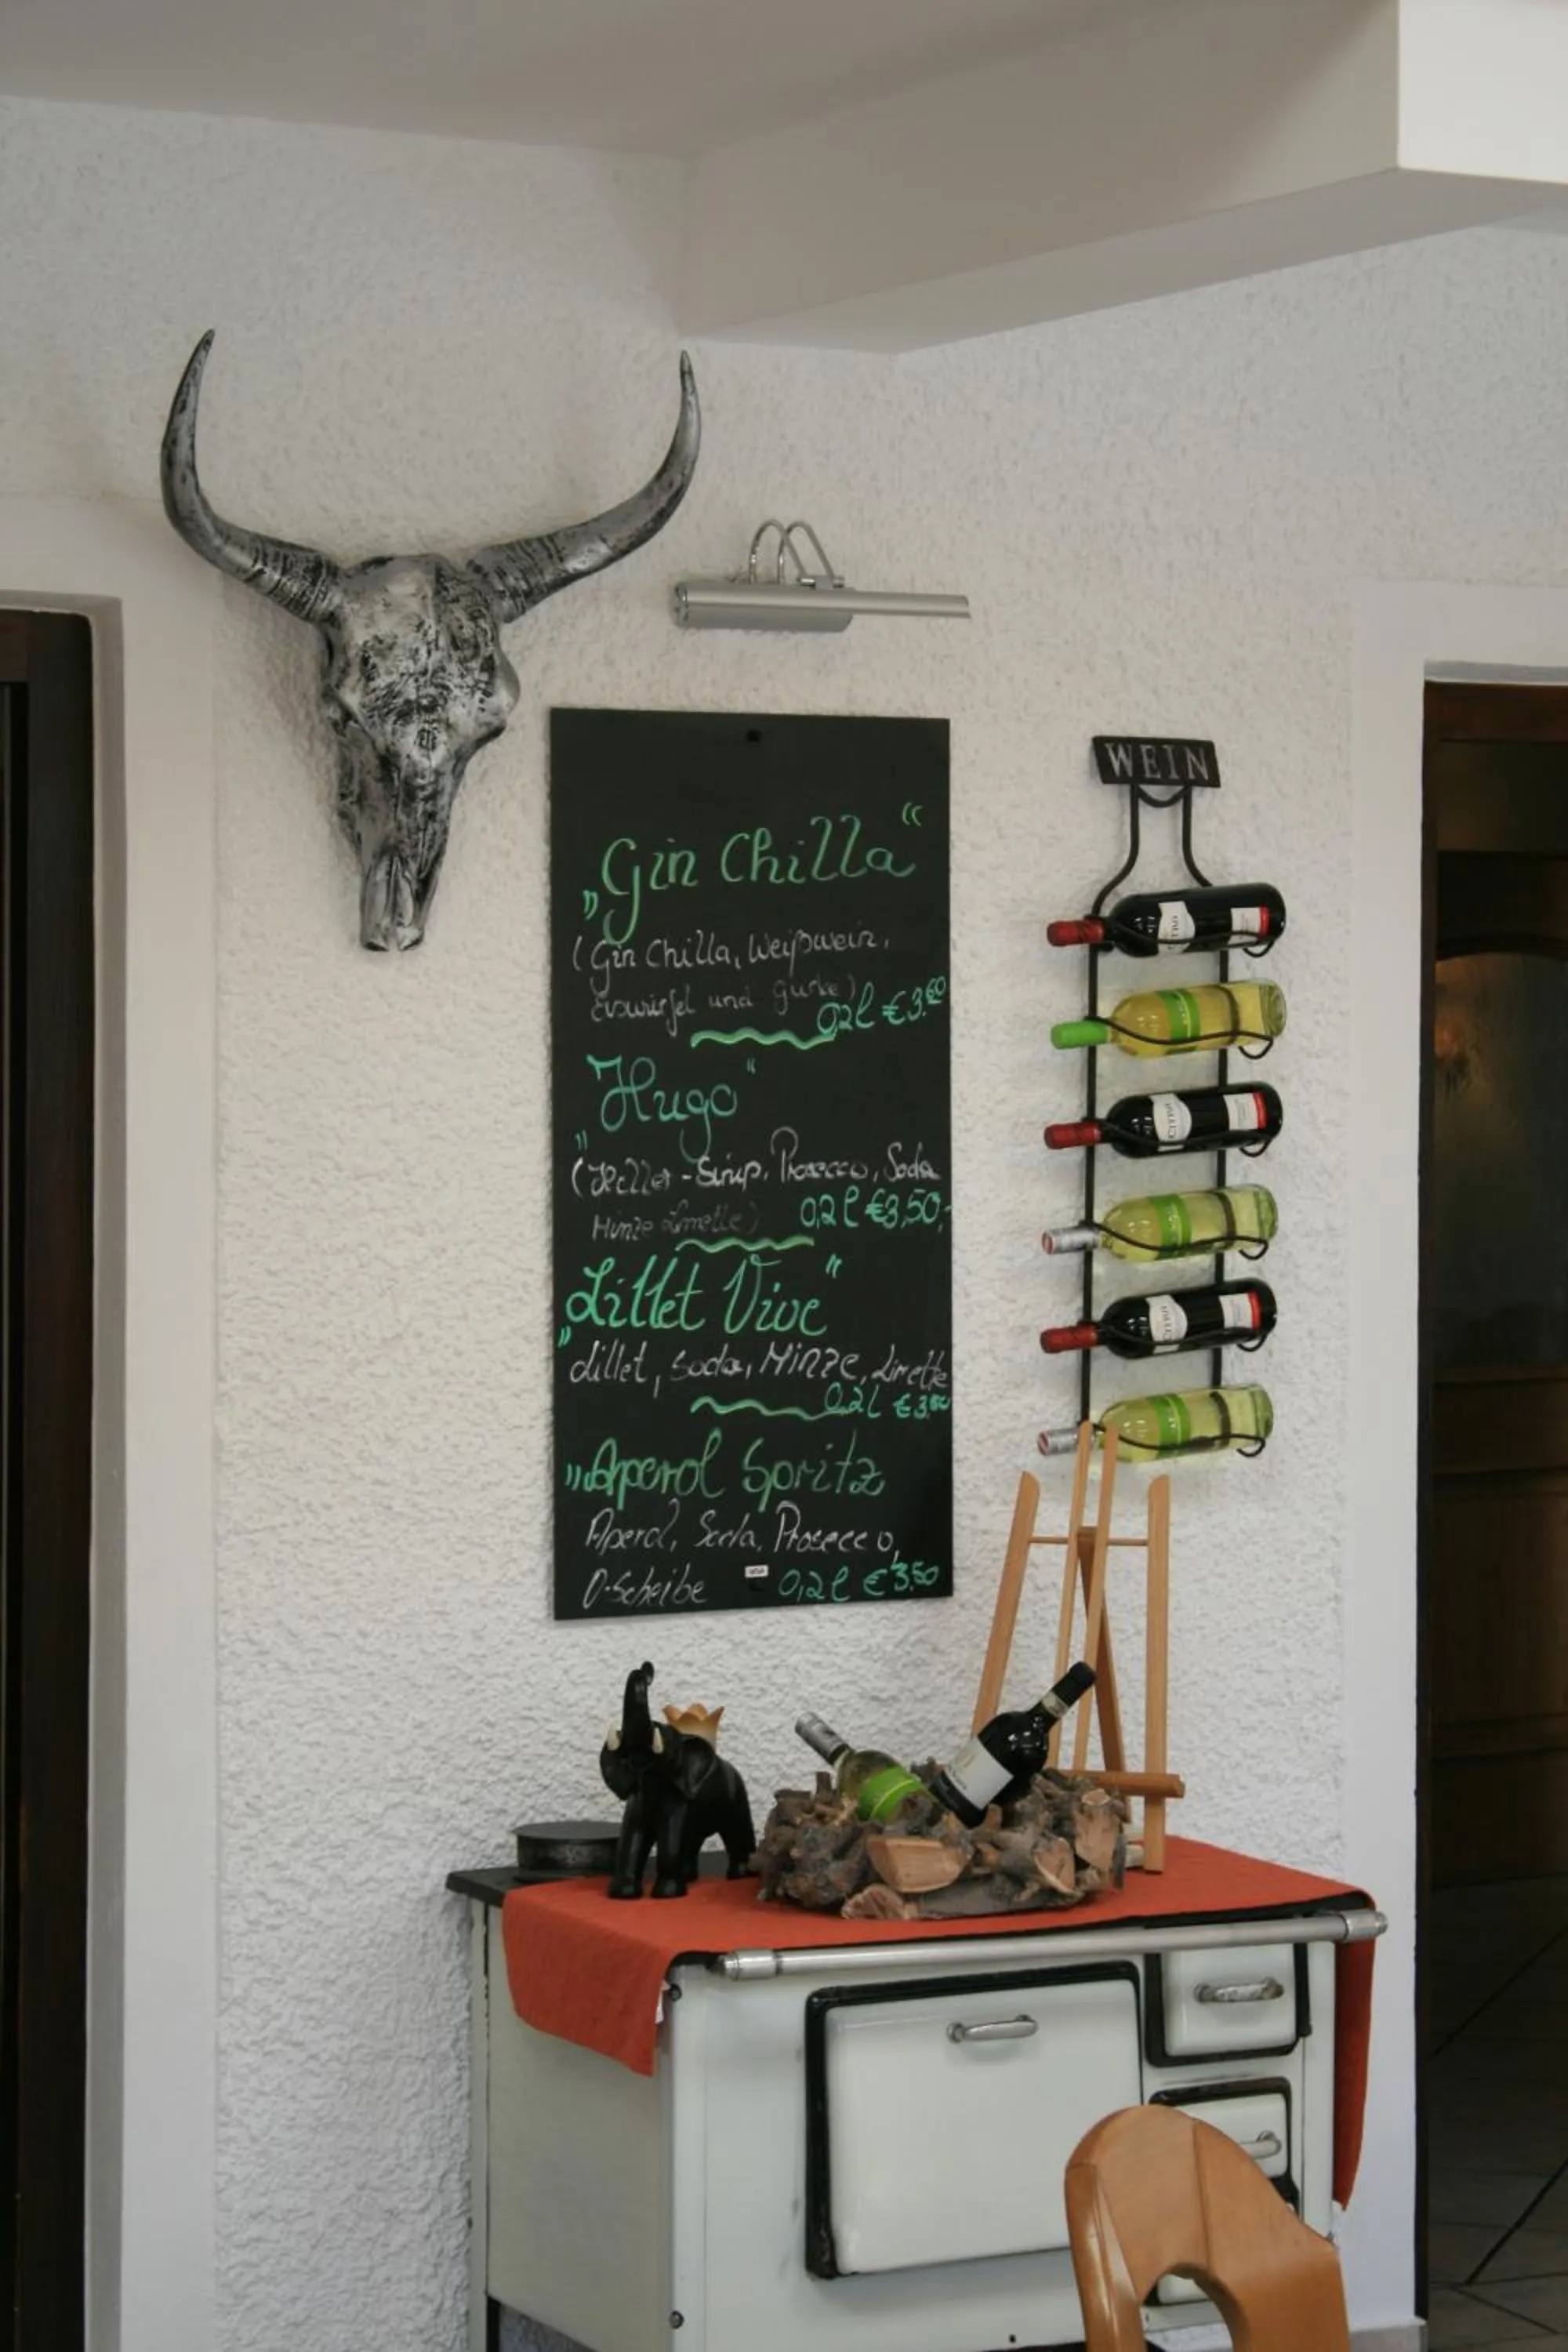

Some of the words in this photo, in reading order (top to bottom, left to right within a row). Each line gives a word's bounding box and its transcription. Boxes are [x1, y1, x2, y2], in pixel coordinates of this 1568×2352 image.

[1104, 742, 1210, 781] WEIN
[645, 928, 742, 970] Chilla,
[708, 985, 753, 1011] und
[884, 1142, 941, 1182] Soda
[741, 1428, 887, 1512] Spritz
